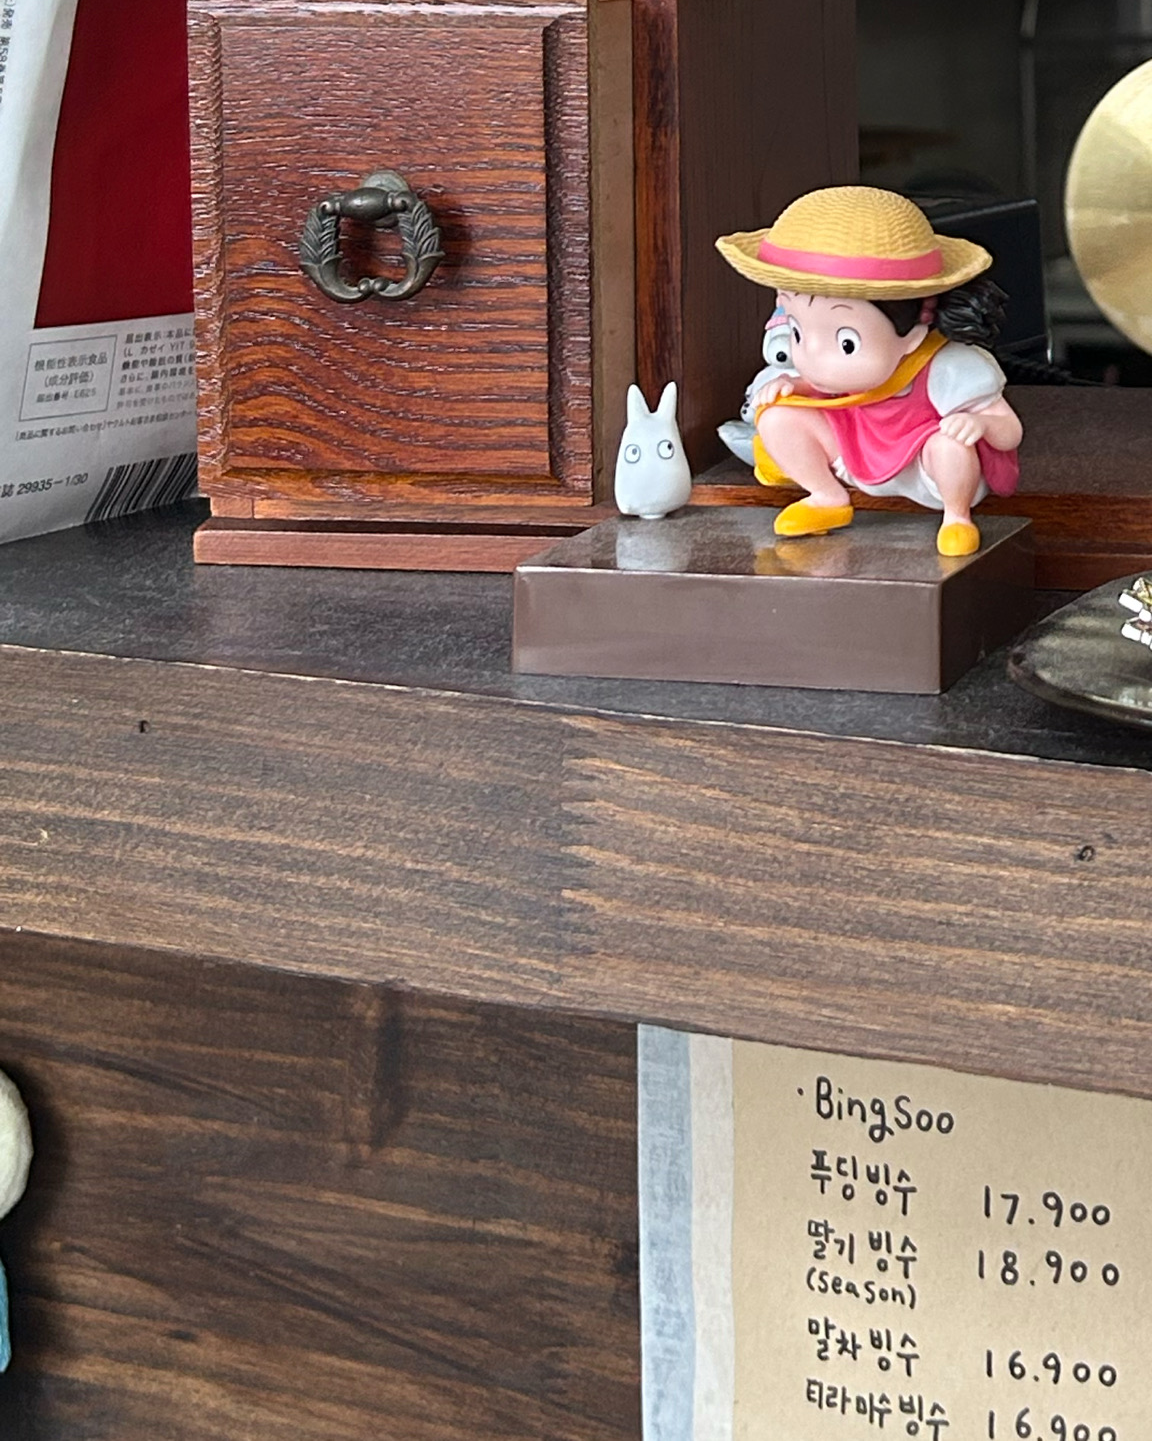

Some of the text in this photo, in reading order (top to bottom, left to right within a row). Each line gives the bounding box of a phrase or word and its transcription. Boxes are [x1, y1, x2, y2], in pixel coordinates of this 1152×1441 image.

[983, 1185, 1111, 1228] 17.900
[807, 1219, 1120, 1286] 딸기 빙수 18.900
[985, 1349, 1117, 1387] 16.900
